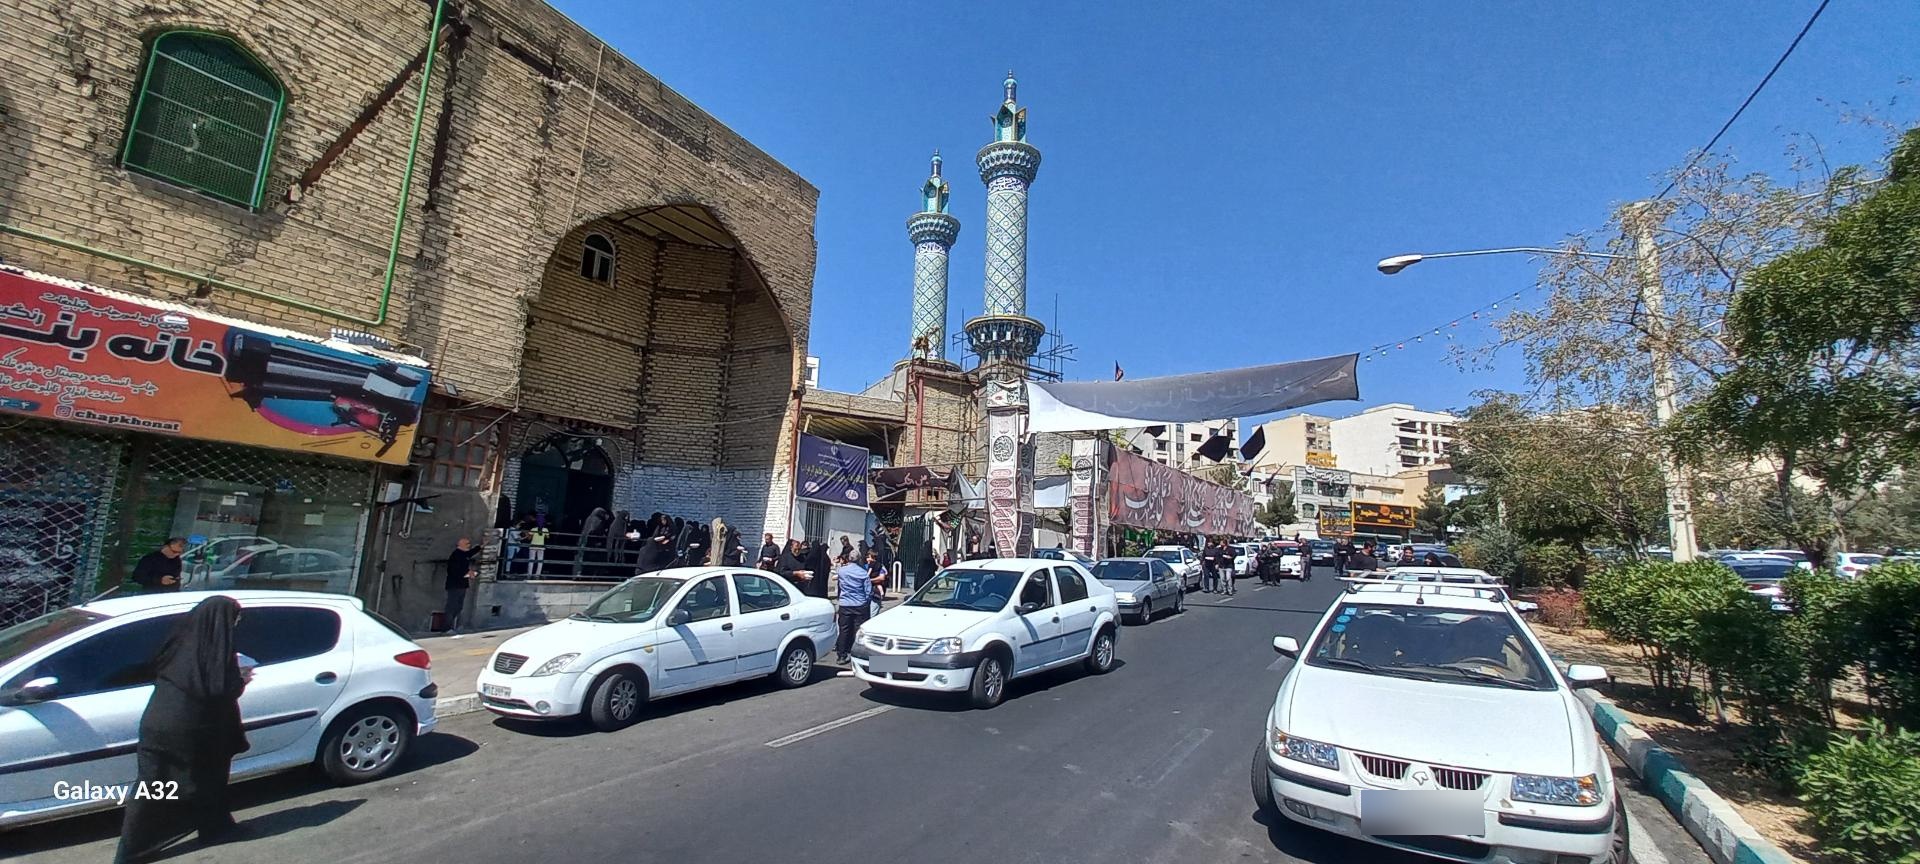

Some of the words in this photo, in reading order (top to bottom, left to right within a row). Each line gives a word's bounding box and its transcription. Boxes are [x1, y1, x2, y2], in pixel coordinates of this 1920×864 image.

[0, 311, 100, 361] بن
[0, 347, 28, 369] فلک
[105, 333, 228, 378] خانه
[130, 380, 159, 396] چاپ
[75, 409, 181, 431] chapkhonat
